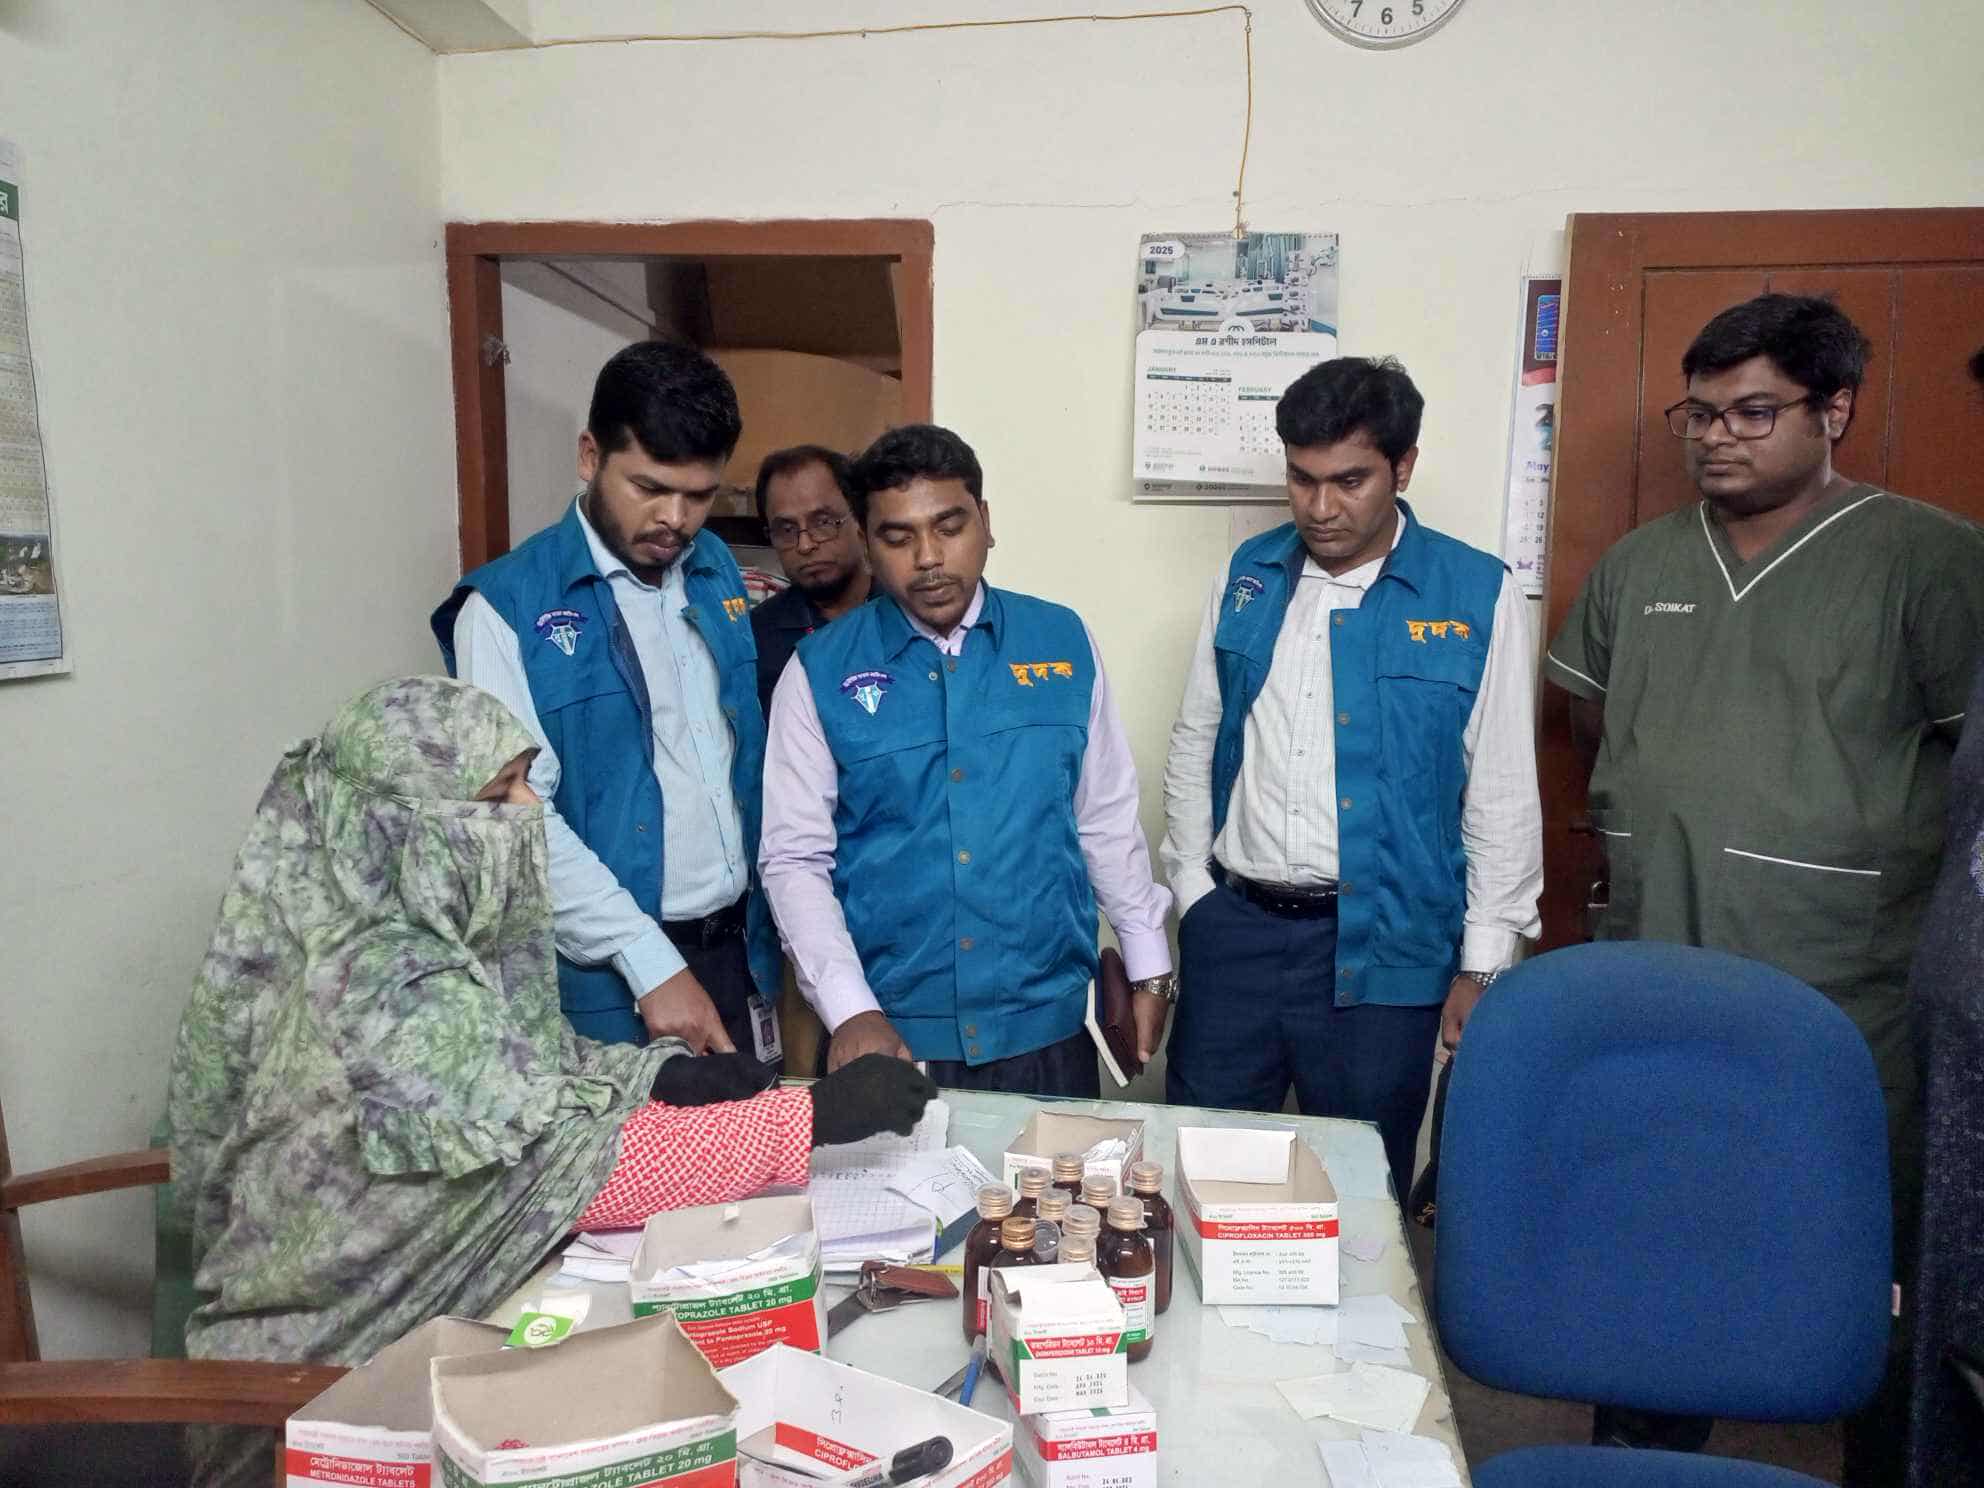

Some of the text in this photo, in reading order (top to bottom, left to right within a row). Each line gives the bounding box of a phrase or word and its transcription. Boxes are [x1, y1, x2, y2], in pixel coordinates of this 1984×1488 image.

[1381, 7, 1393, 25] 6
[1412, 0, 1424, 15] 5
[1406, 619, 1470, 644] দুদক
[1009, 662, 1073, 688] দুদক
[728, 1301, 764, 1315] TABLET
[765, 1299, 776, 1308] 20
[778, 1296, 793, 1306] mg
[1057, 1449, 1105, 1460] SALBUTAMOL
[1107, 1446, 1132, 1456] TABLET
[626, 1464, 675, 1483] TABLET
[676, 1459, 690, 1471] 20
[694, 1454, 713, 1467] mg
[310, 1469, 416, 1488] METRONIDAZOLE TABLETS
